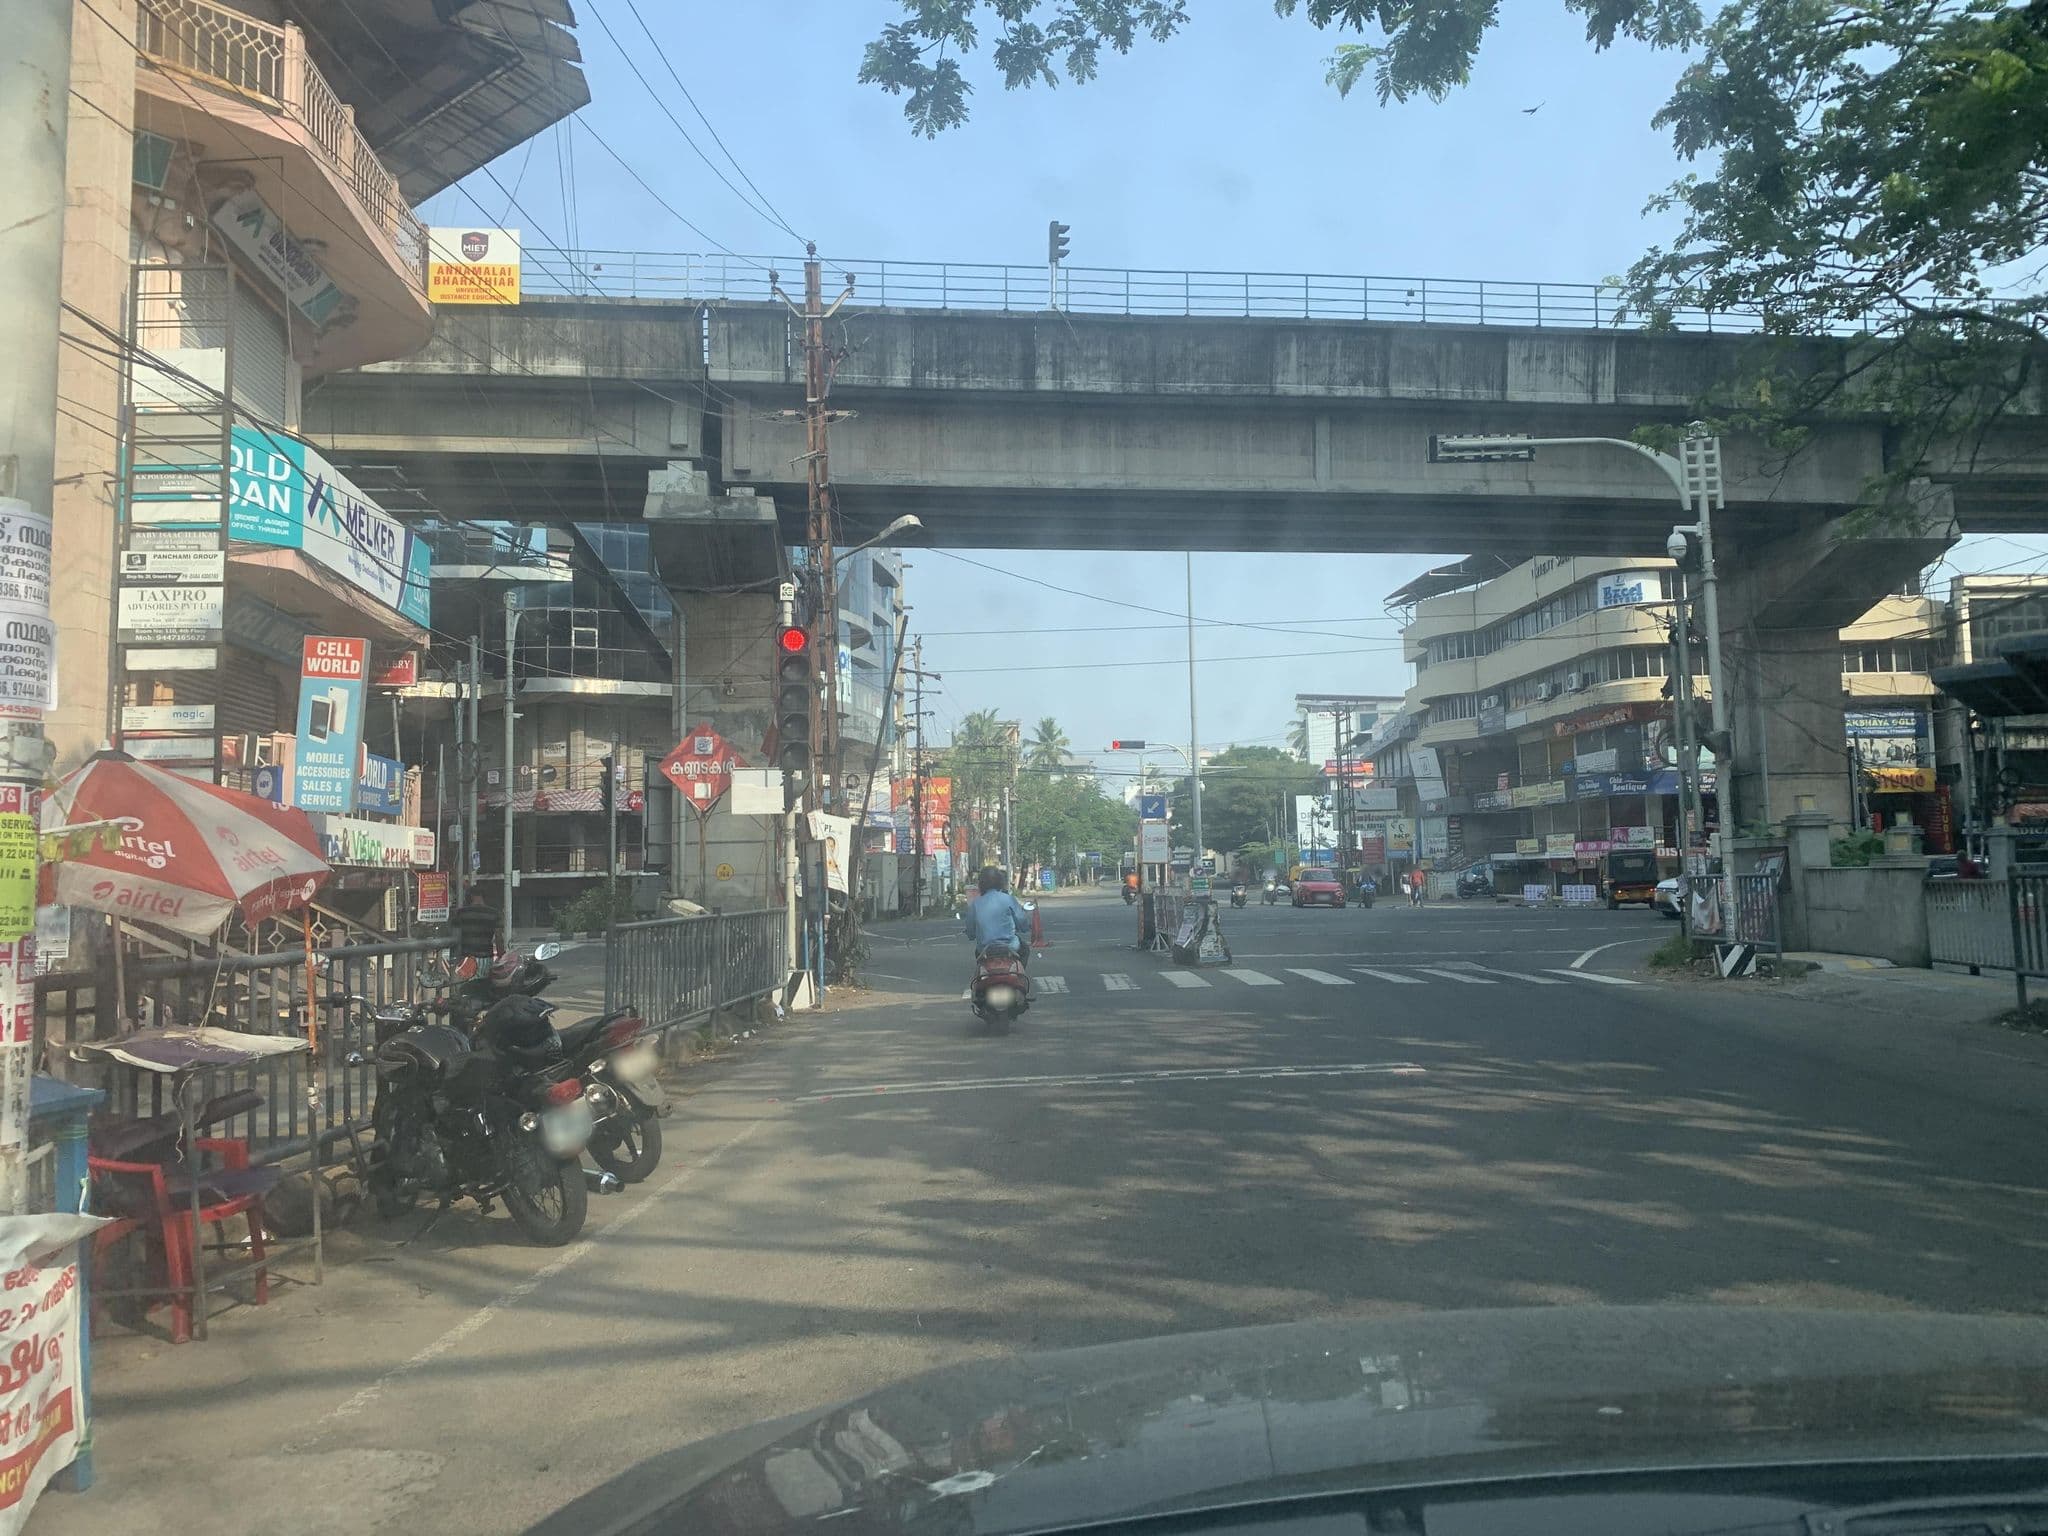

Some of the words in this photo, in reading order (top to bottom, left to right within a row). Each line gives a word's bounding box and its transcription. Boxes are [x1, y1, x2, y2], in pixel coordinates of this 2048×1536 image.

[463, 244, 487, 252] MIET
[437, 265, 512, 276] ANNAMALAI
[433, 277, 515, 287] BHARATHIAR
[346, 495, 396, 563] MELKER
[137, 589, 207, 602] TAXPRO
[127, 603, 179, 611] ADVISORIES
[181, 603, 198, 611] PVT
[200, 603, 217, 611] LTD
[317, 641, 353, 657] CELL
[307, 657, 360, 675] WORLD
[173, 710, 205, 719] magic
[1846, 719, 1890, 727] AKSHAYA
[306, 752, 345, 764] MOBILE
[297, 767, 351, 779] ACCESSORIES
[360, 757, 387, 790] ORLD
[303, 780, 332, 792] SALES
[335, 782, 343, 792] &
[1612, 783, 1647, 792] Boutique
[300, 794, 342, 807] SERVICE
[234, 847, 287, 872] airtel
[117, 886, 184, 918] airtel
